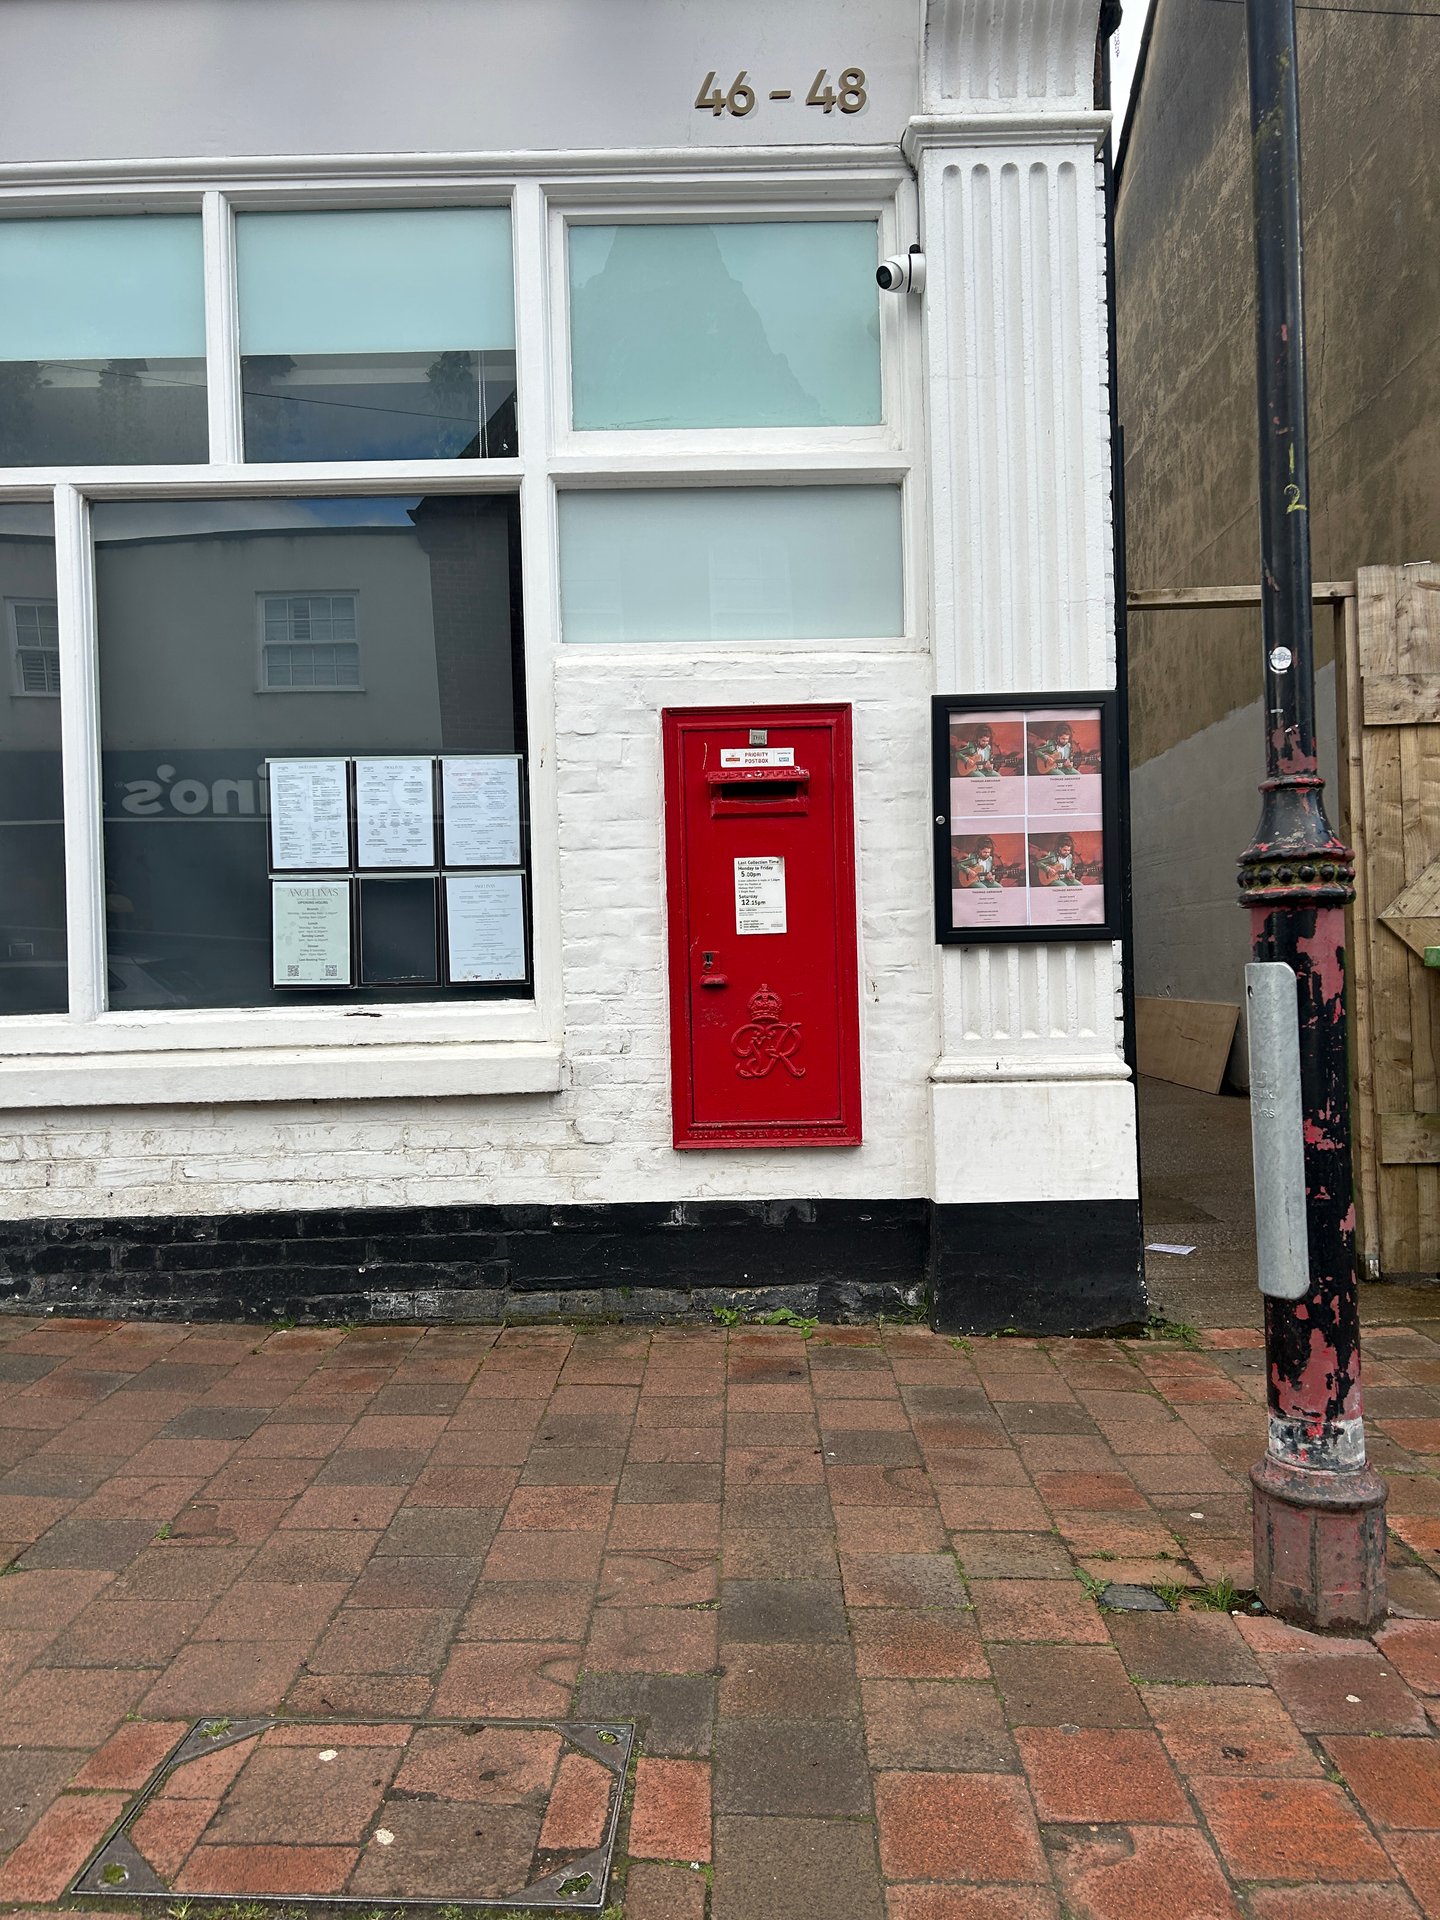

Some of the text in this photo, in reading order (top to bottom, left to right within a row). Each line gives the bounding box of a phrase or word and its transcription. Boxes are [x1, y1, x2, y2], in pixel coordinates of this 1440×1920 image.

[695, 71, 756, 117] 46
[805, 67, 868, 114] 48
[287, 888, 339, 897] ANGELINAS
